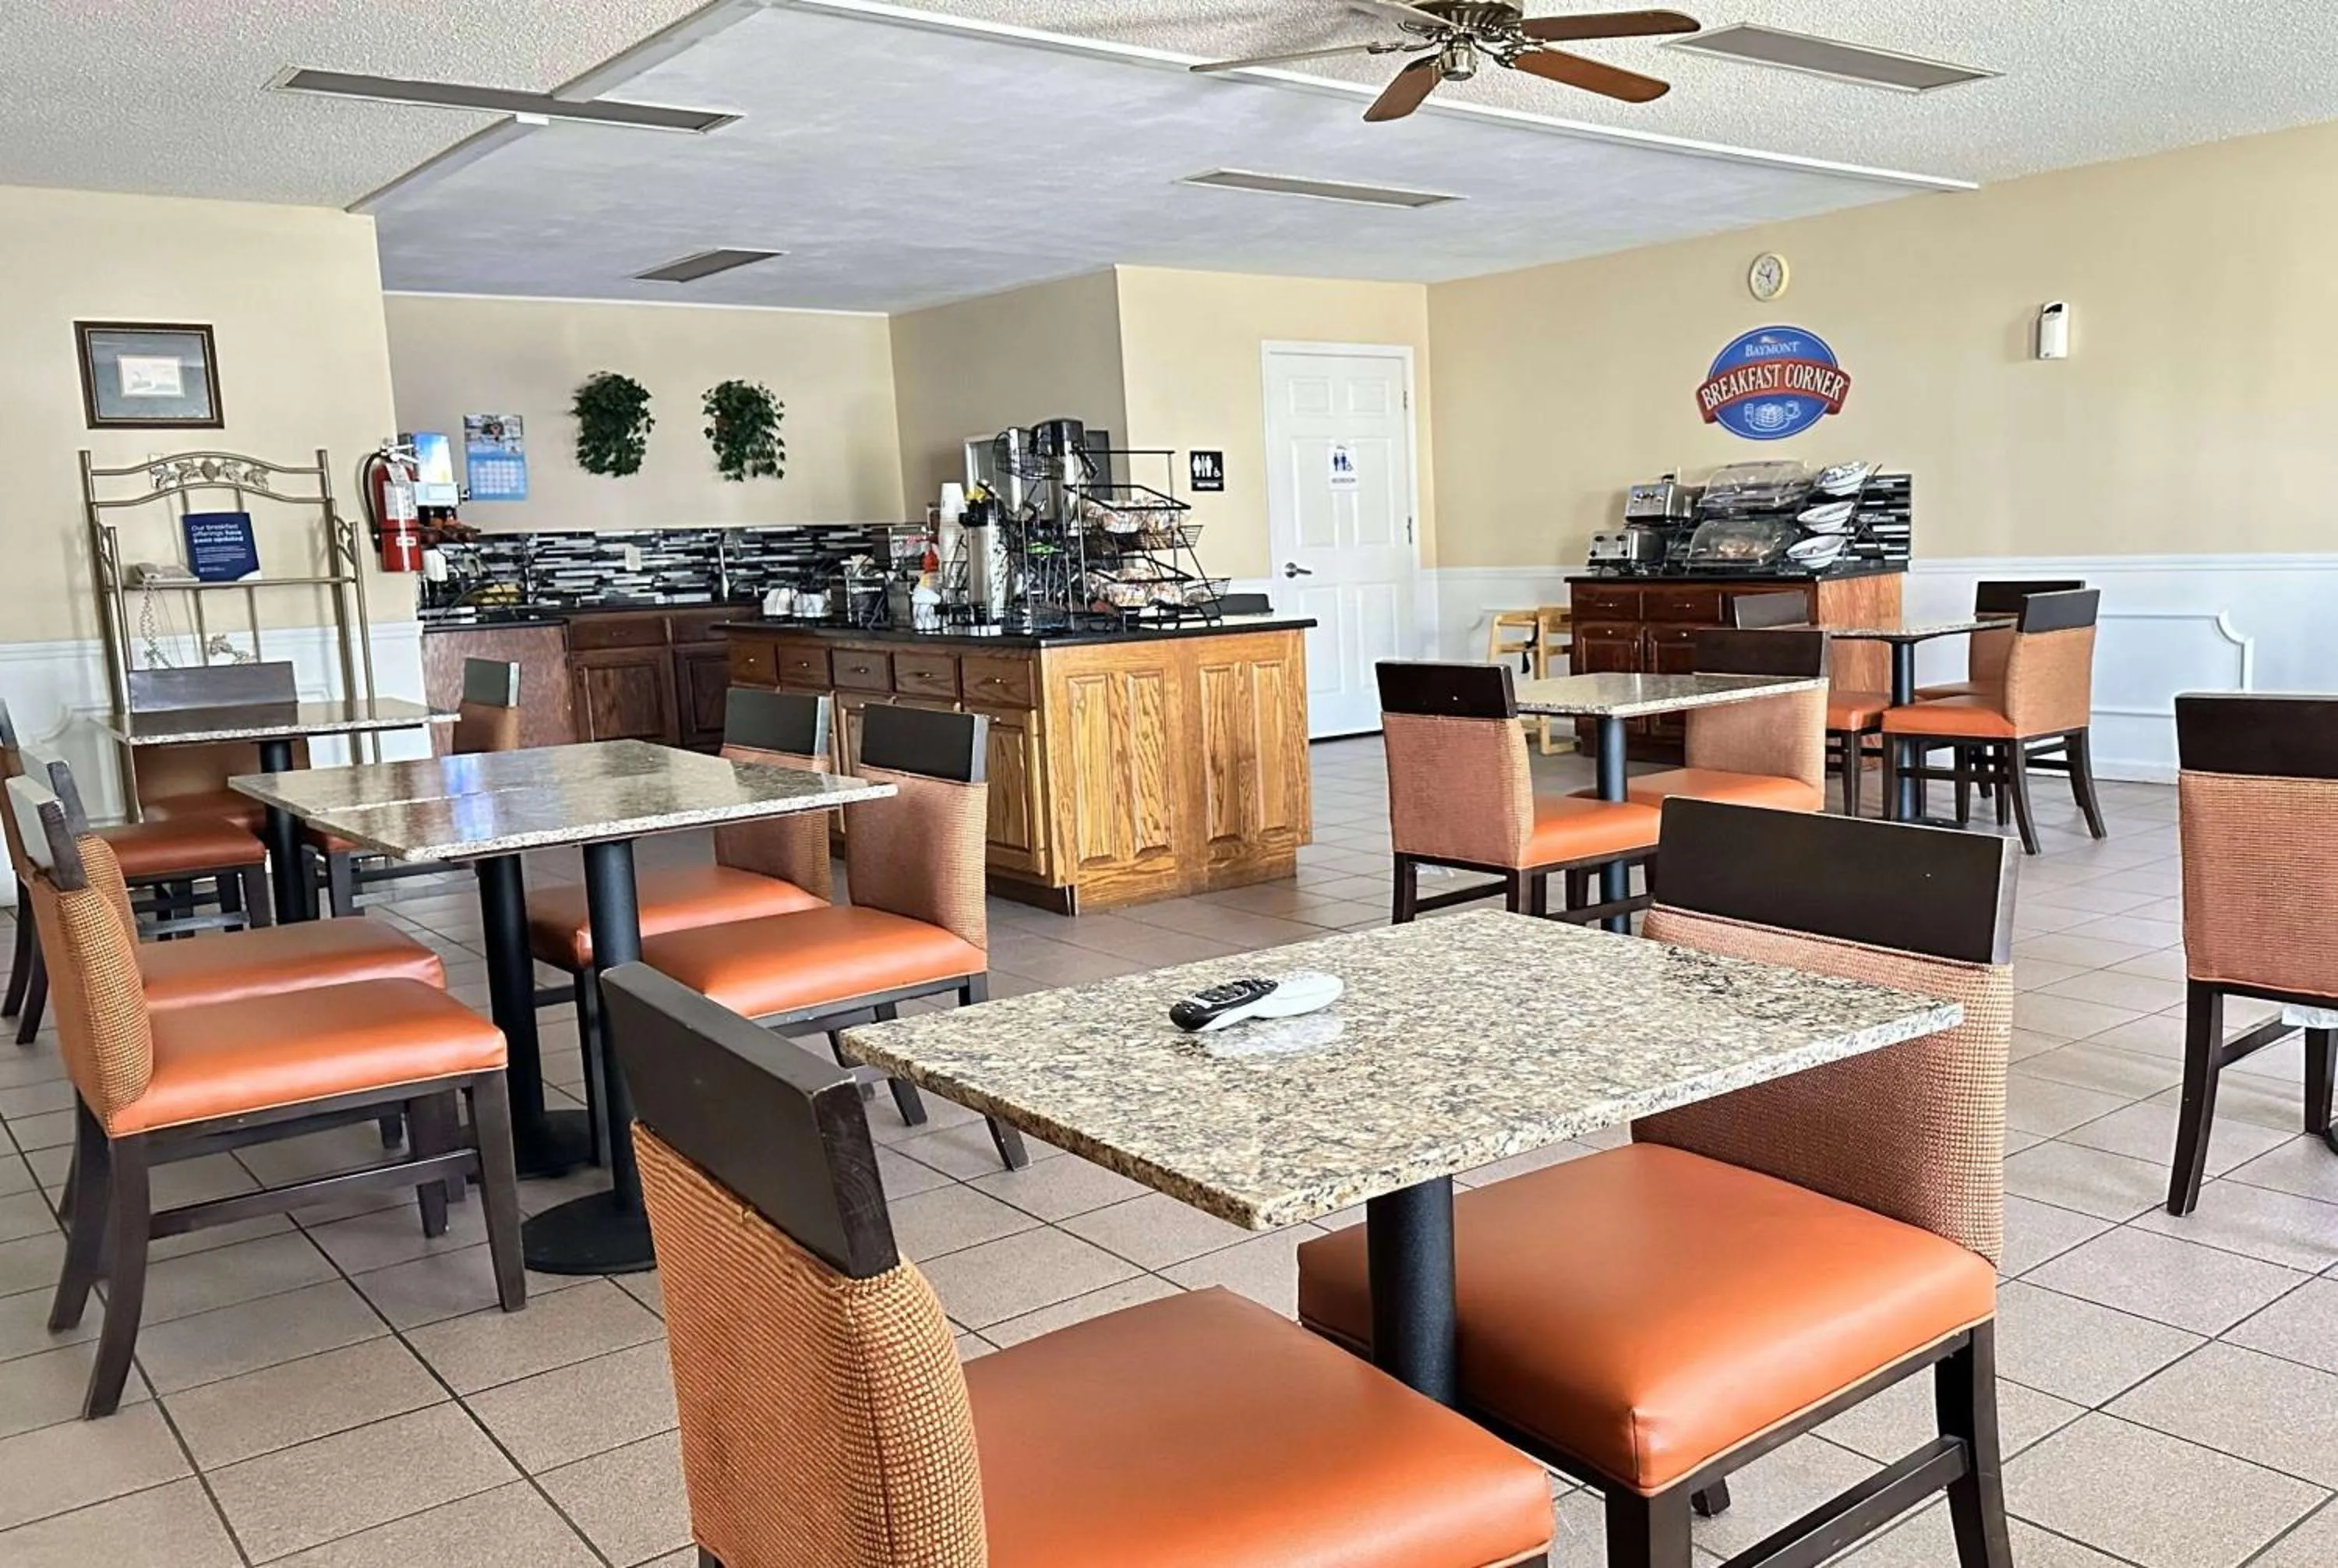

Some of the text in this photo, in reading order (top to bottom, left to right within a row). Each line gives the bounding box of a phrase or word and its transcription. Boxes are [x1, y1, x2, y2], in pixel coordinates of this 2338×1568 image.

[1745, 341, 1801, 357] BAYMONT
[1701, 364, 1844, 410] BREAKFAST CORNER
